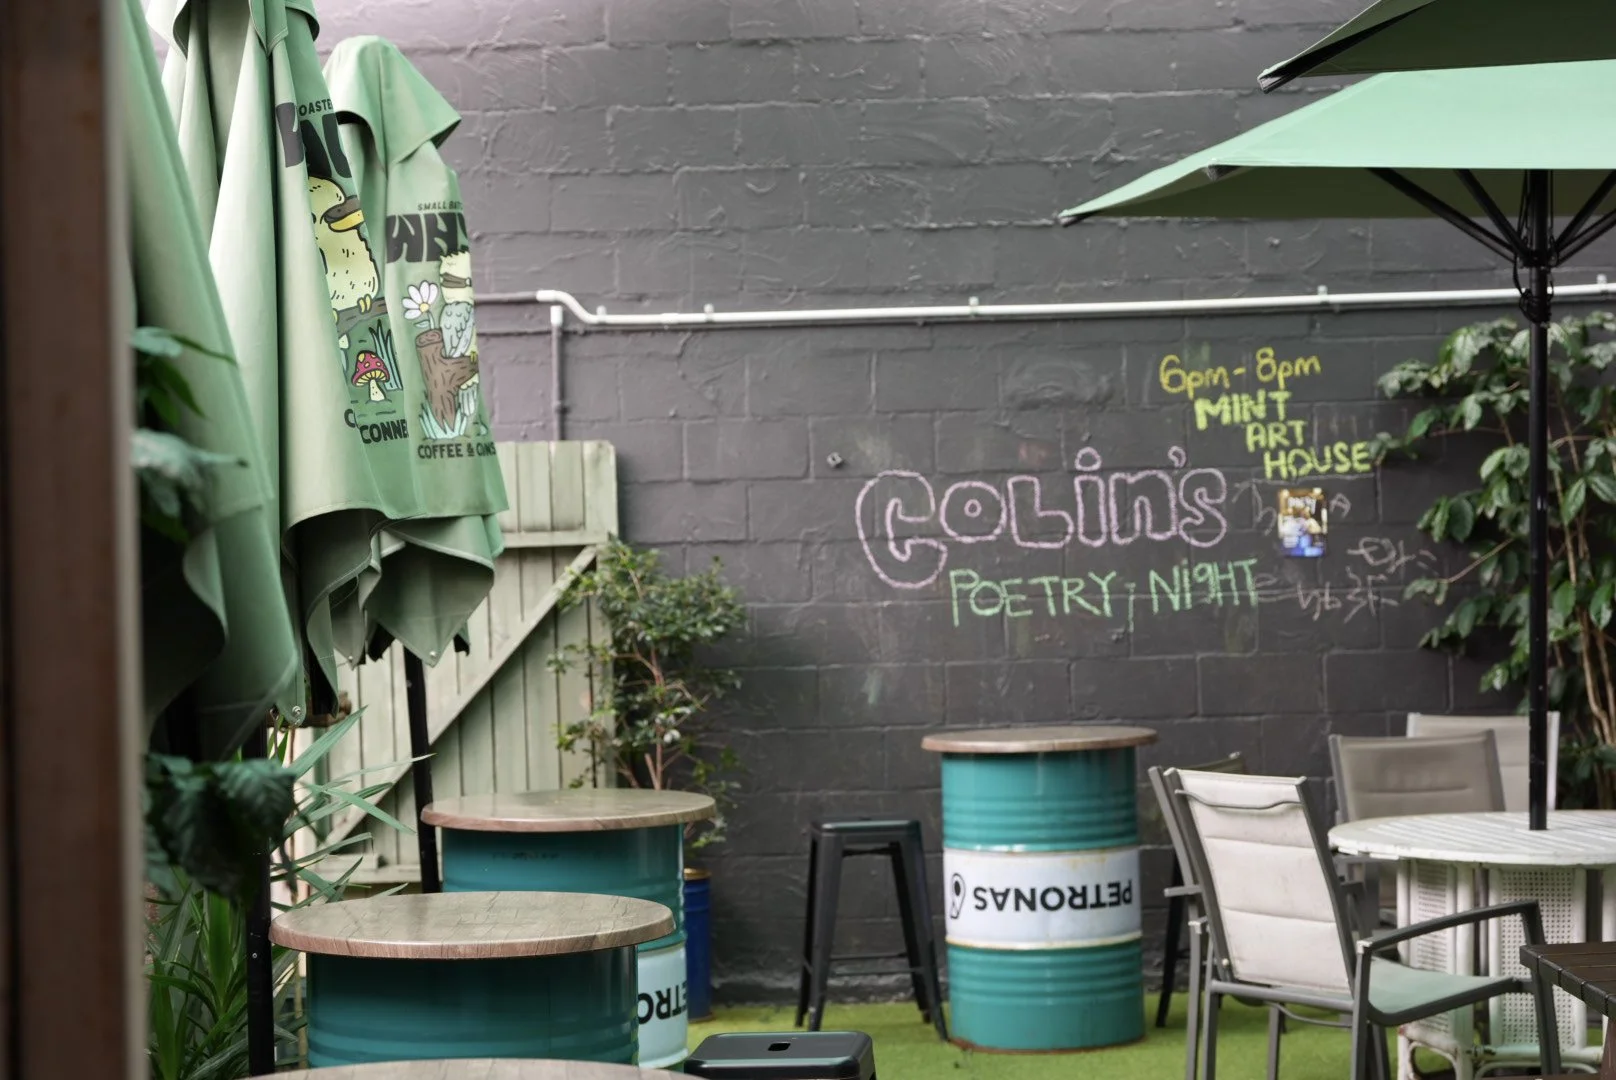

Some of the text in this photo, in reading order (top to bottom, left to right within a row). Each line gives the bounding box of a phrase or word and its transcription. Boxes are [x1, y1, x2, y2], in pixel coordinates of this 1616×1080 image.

[417, 202, 447, 211] SMALL
[1255, 347, 1322, 390] 8pm
[1194, 388, 1293, 431] MINT
[417, 443, 464, 459] COFFEE
[466, 442, 475, 457] &
[1245, 420, 1308, 453] ART
[1263, 441, 1372, 480] HOUSE
[949, 567, 1117, 628] POETRY
[973, 879, 1133, 912] PETRONAS
